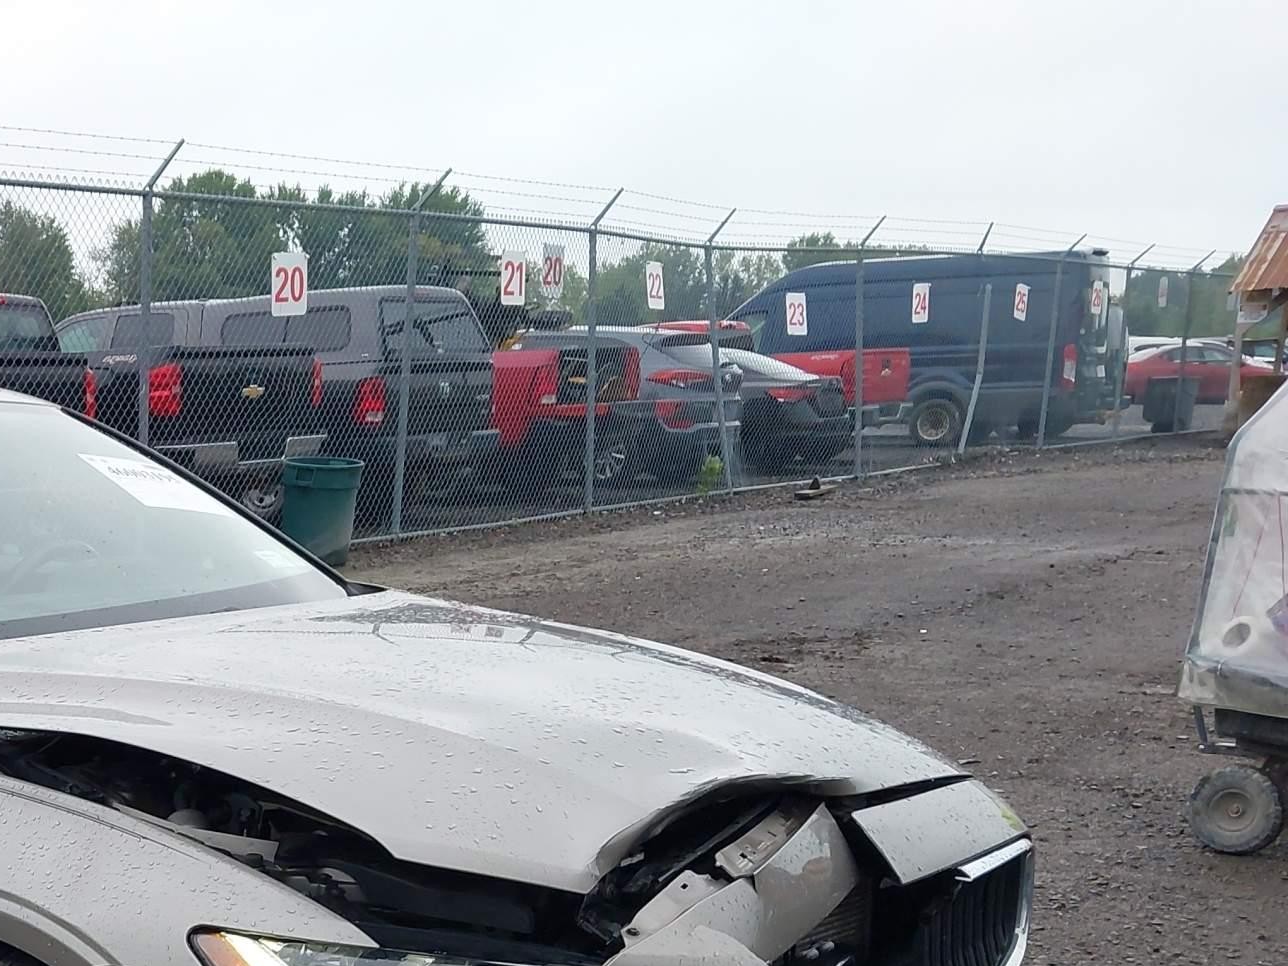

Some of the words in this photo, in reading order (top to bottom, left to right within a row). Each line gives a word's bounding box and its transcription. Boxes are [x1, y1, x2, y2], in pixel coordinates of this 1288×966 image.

[274, 266, 304, 303] 20
[503, 260, 523, 297] 21
[543, 256, 562, 287] 20
[648, 271, 662, 299] 22
[789, 302, 805, 326] 23
[914, 292, 927, 315] 24
[1015, 290, 1027, 313] 25
